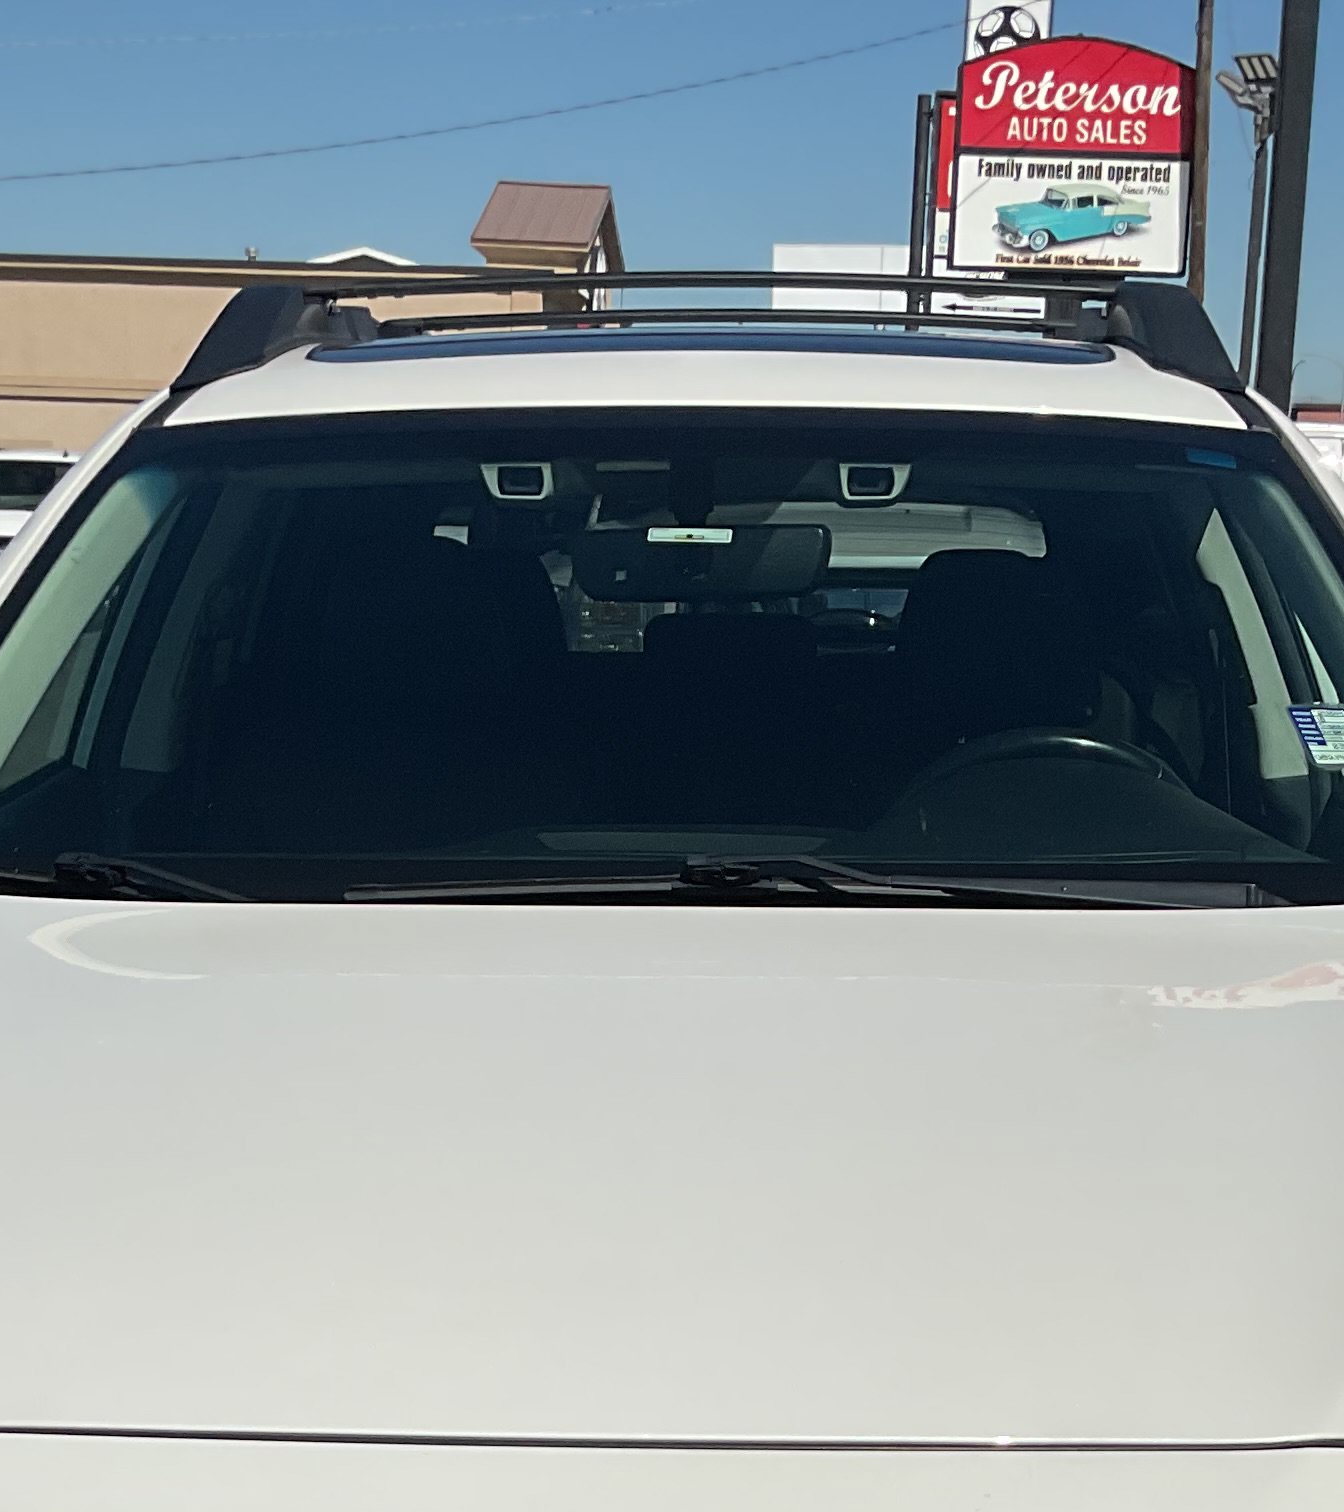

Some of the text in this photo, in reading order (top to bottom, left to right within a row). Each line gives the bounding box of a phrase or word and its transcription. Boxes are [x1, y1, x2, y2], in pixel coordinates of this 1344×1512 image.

[974, 60, 1182, 116] Peterson
[1006, 116, 1147, 145] AUTO SALES
[977, 158, 1171, 184] Family owned and operated
